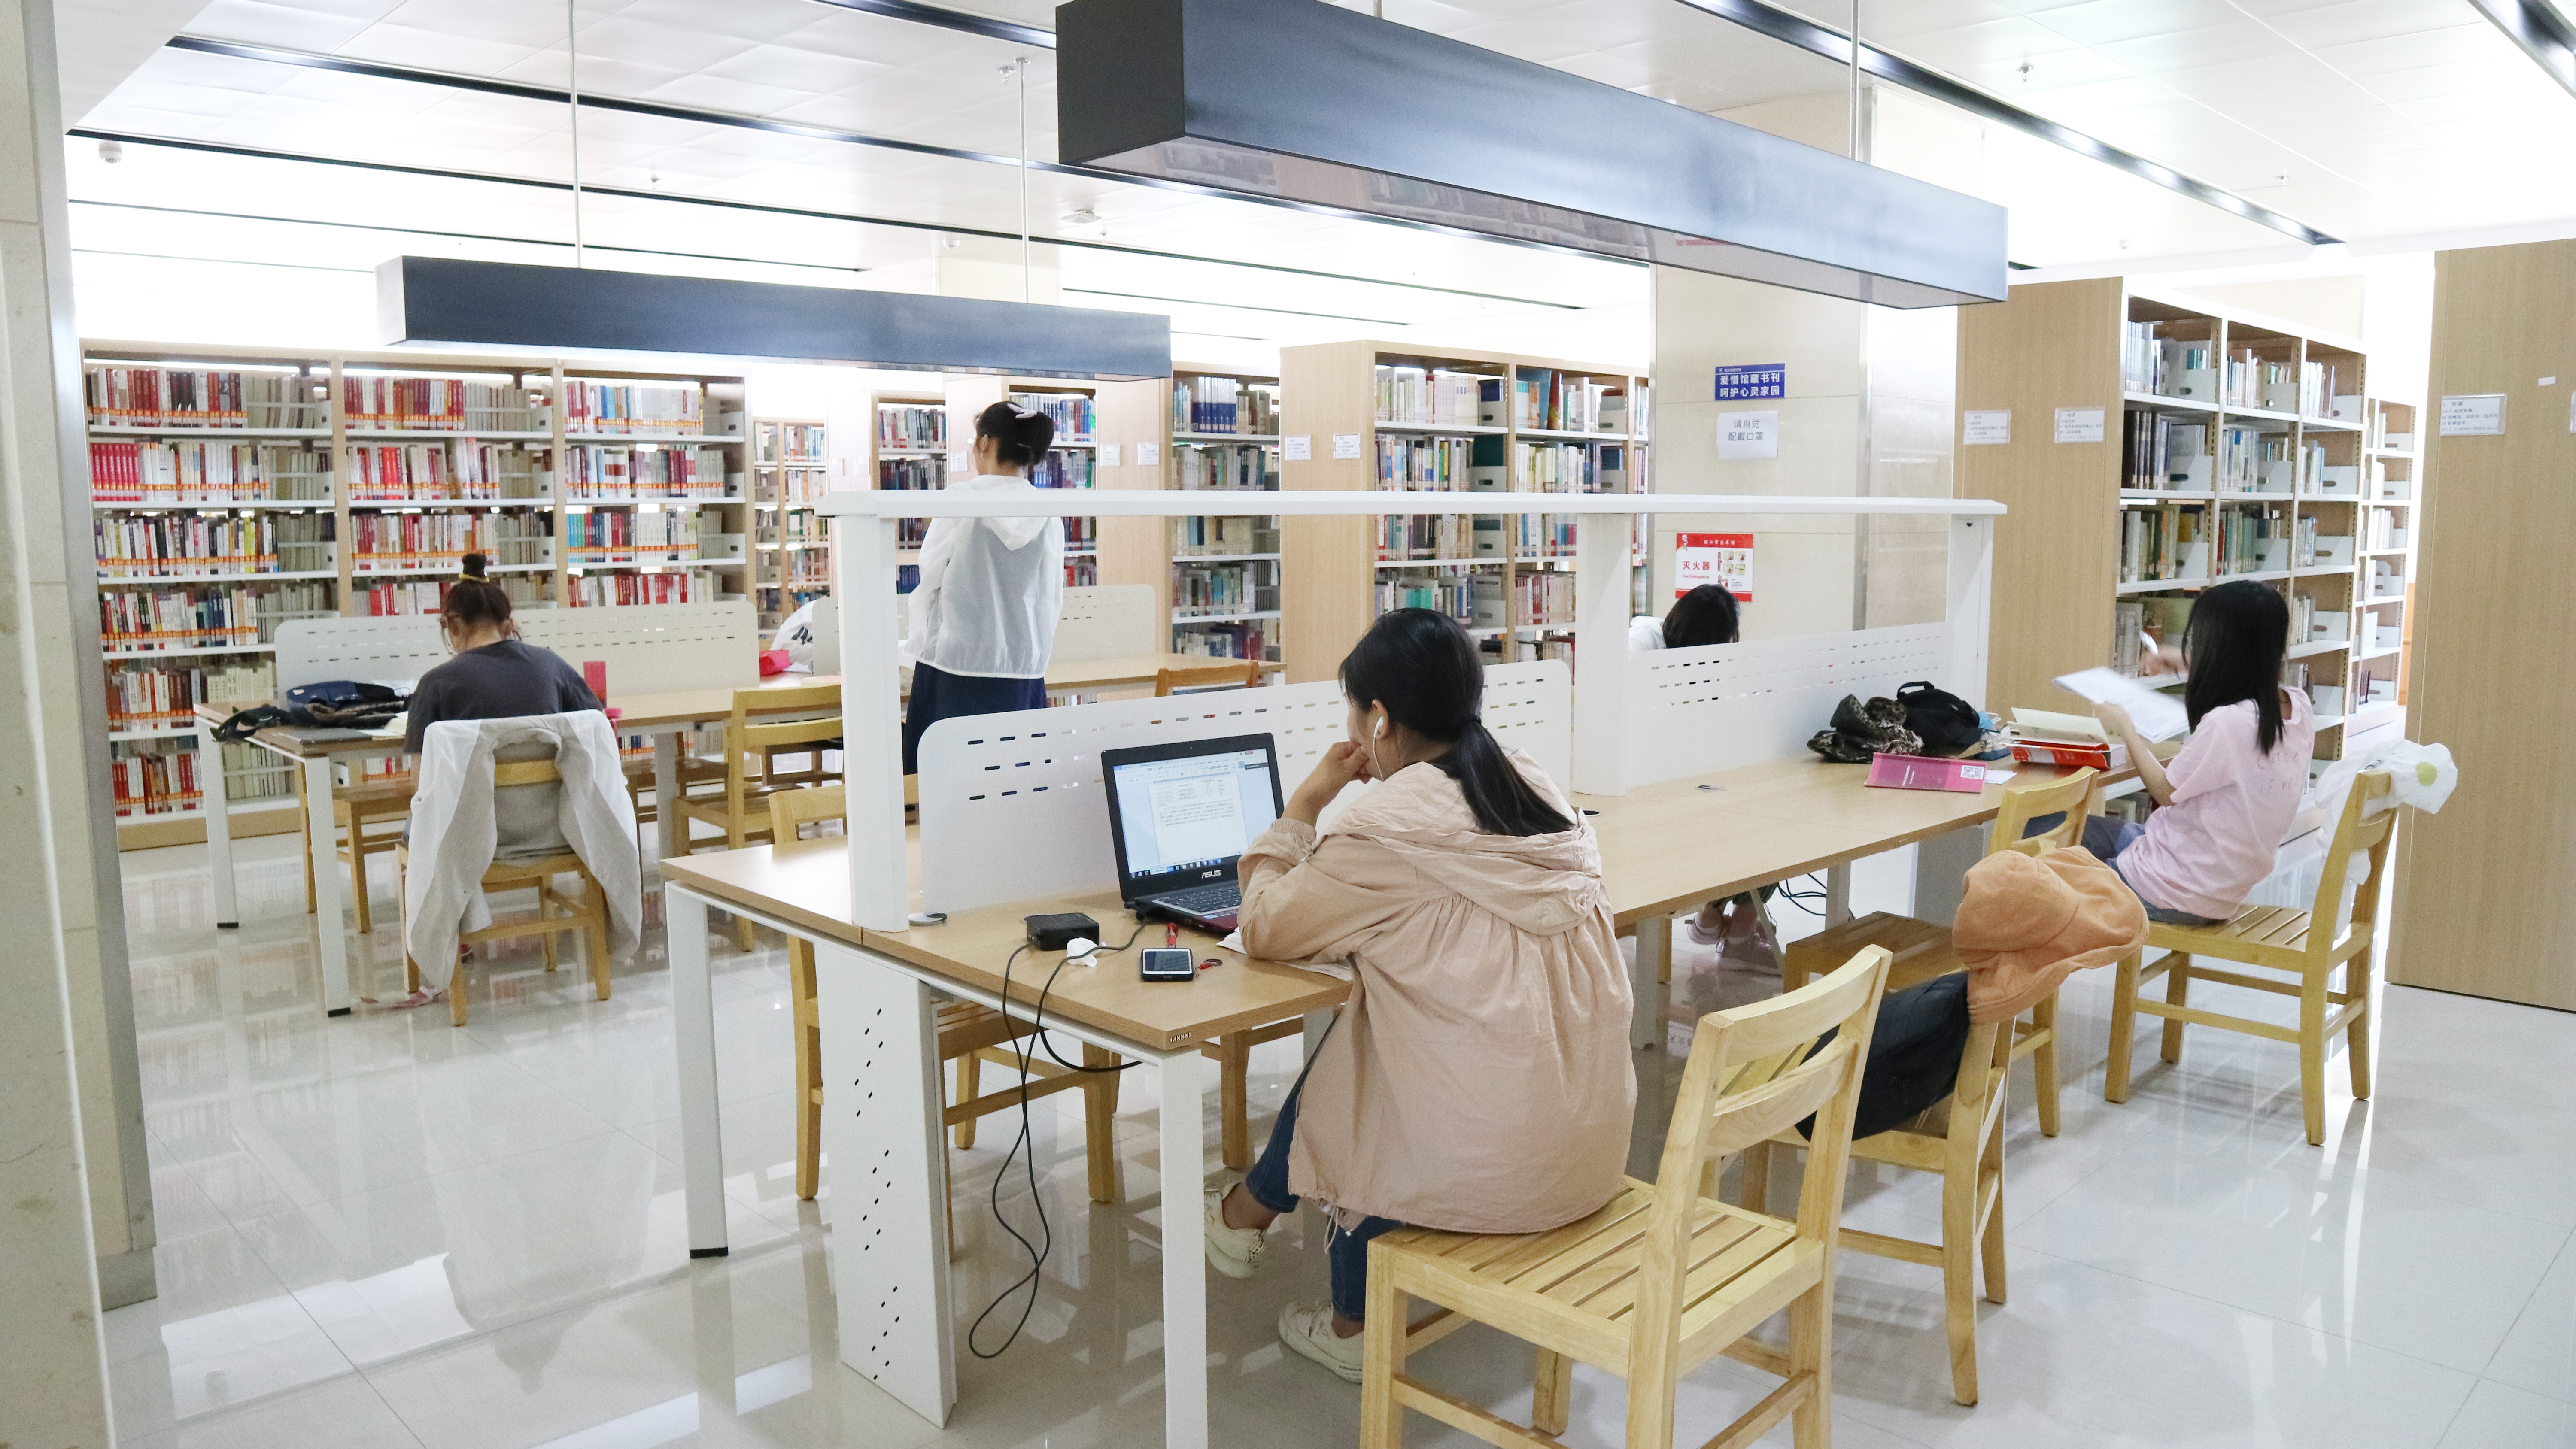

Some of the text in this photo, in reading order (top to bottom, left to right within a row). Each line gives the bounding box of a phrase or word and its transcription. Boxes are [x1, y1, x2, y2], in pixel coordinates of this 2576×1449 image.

[1720, 373, 1780, 385] 爱惜馆藏书刊
[1720, 385, 1780, 397] 呵护心灵家园
[1734, 420, 1760, 428] 请自觉
[1728, 432, 1763, 441] 配戴口罩
[1683, 561, 1710, 570] 灭火器
[1201, 869, 1221, 879] ASUS
